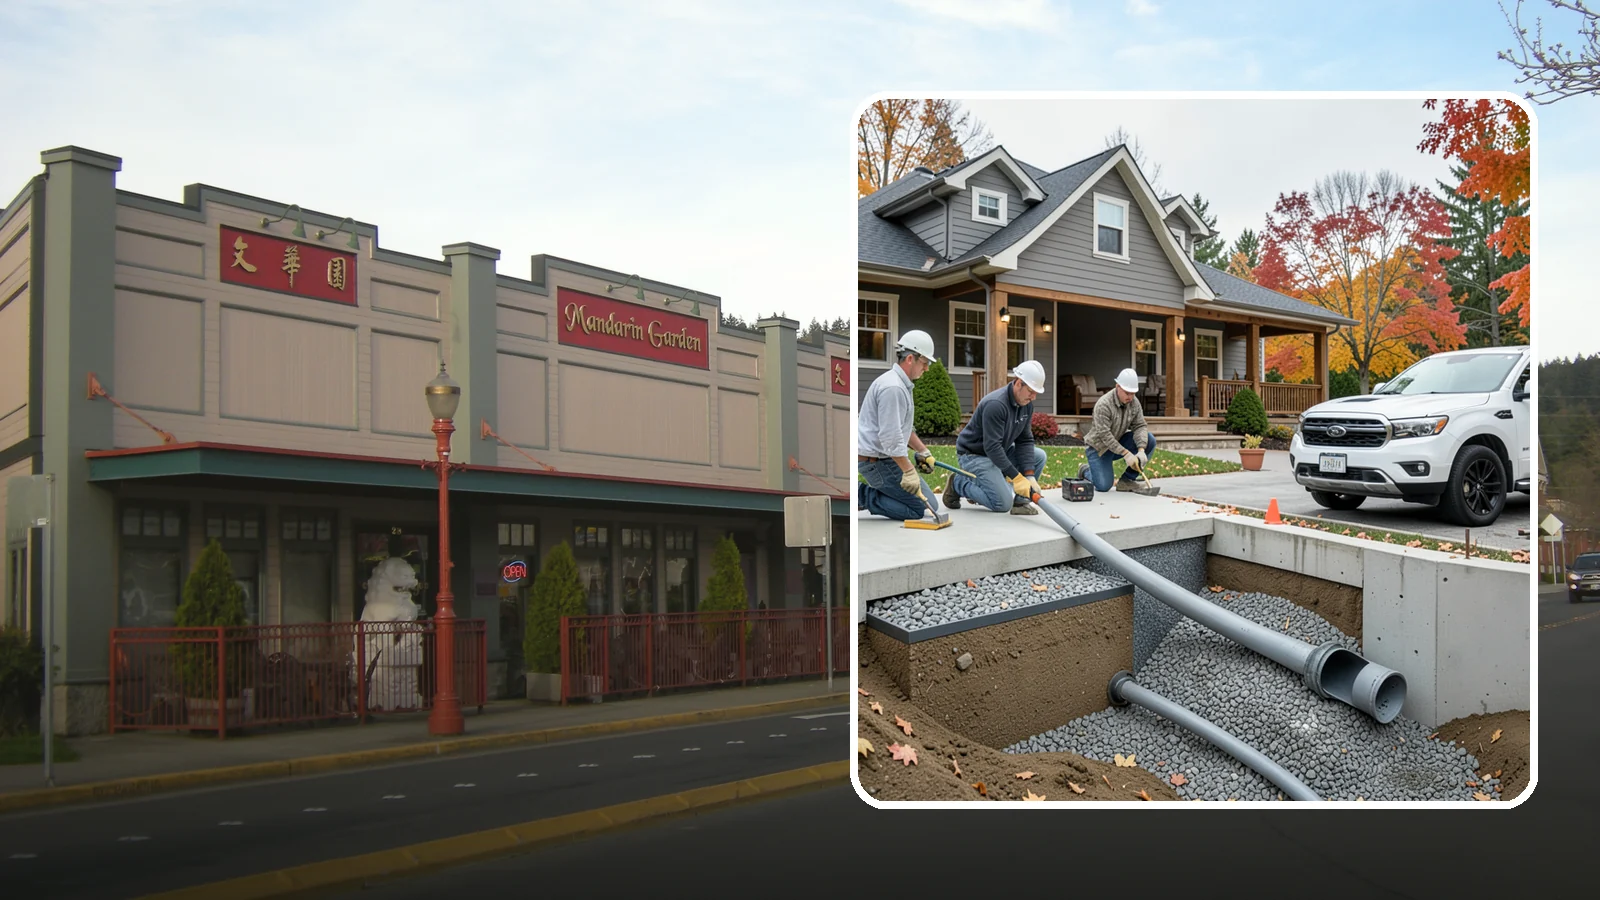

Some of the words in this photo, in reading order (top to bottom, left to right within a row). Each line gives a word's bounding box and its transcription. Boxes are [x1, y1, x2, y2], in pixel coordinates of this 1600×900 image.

[565, 302, 644, 341] Mandarin
[648, 320, 701, 352] Garden
[503, 565, 527, 579] OPEN
